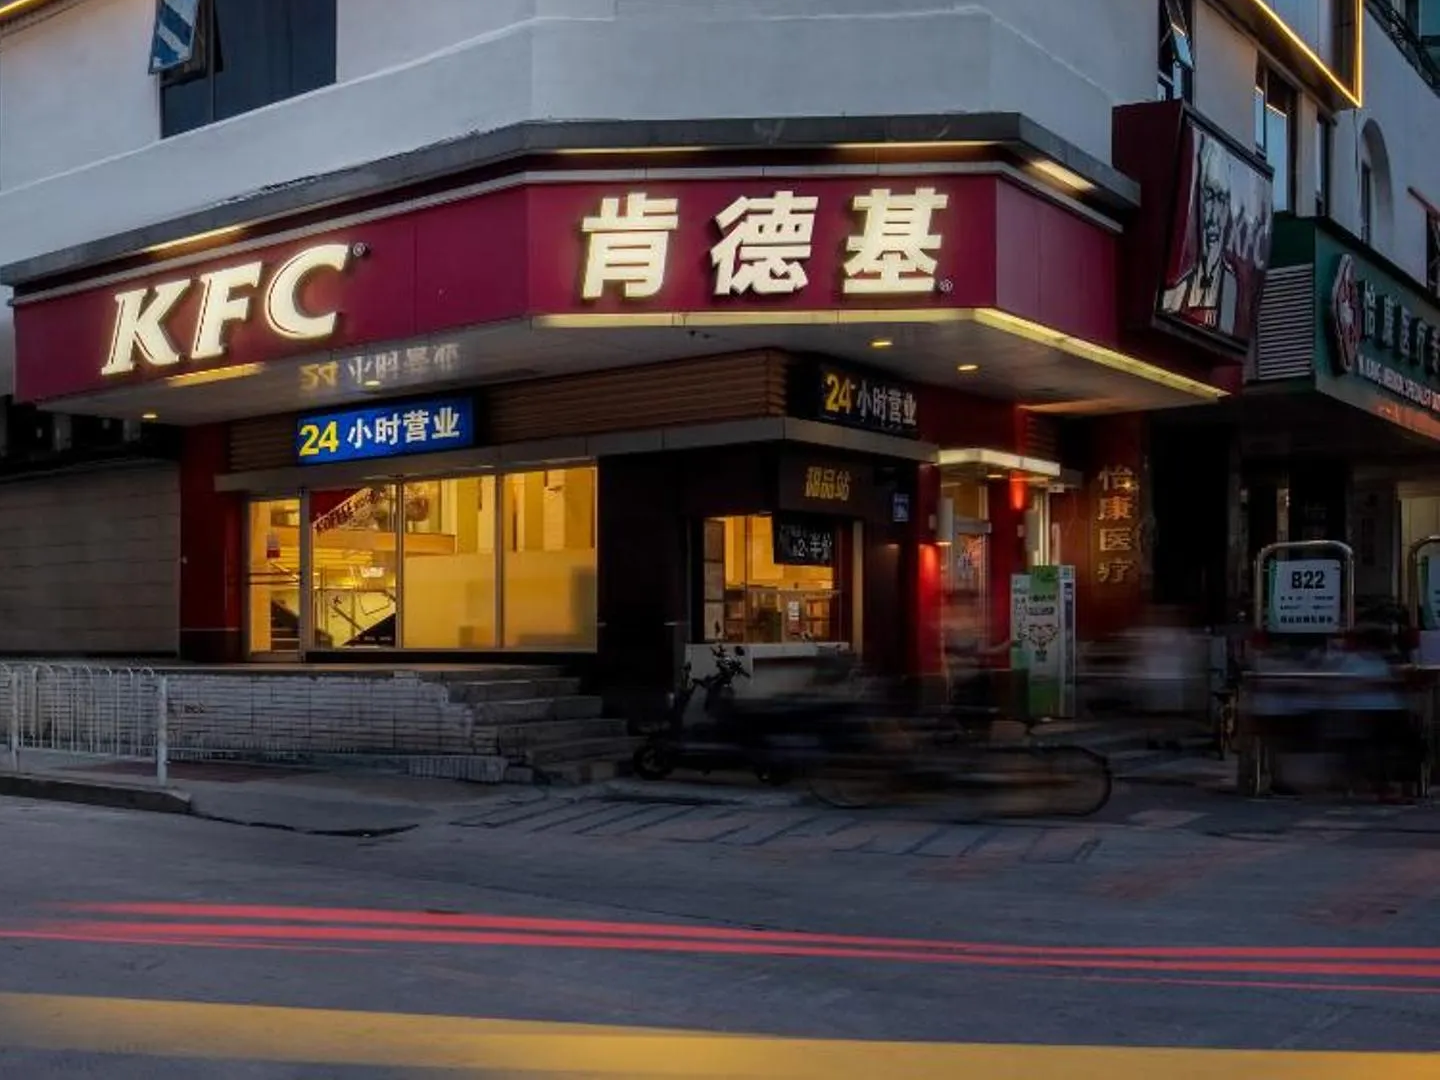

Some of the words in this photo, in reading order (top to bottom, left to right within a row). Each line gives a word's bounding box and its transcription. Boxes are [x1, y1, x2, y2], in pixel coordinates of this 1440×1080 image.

[580, 187, 951, 301] 肯德基
[100, 242, 353, 376] KFC
[298, 407, 460, 457] 24小时营业
[823, 372, 918, 427] 24小时营业
[1097, 463, 1137, 584] 怡康医疗
